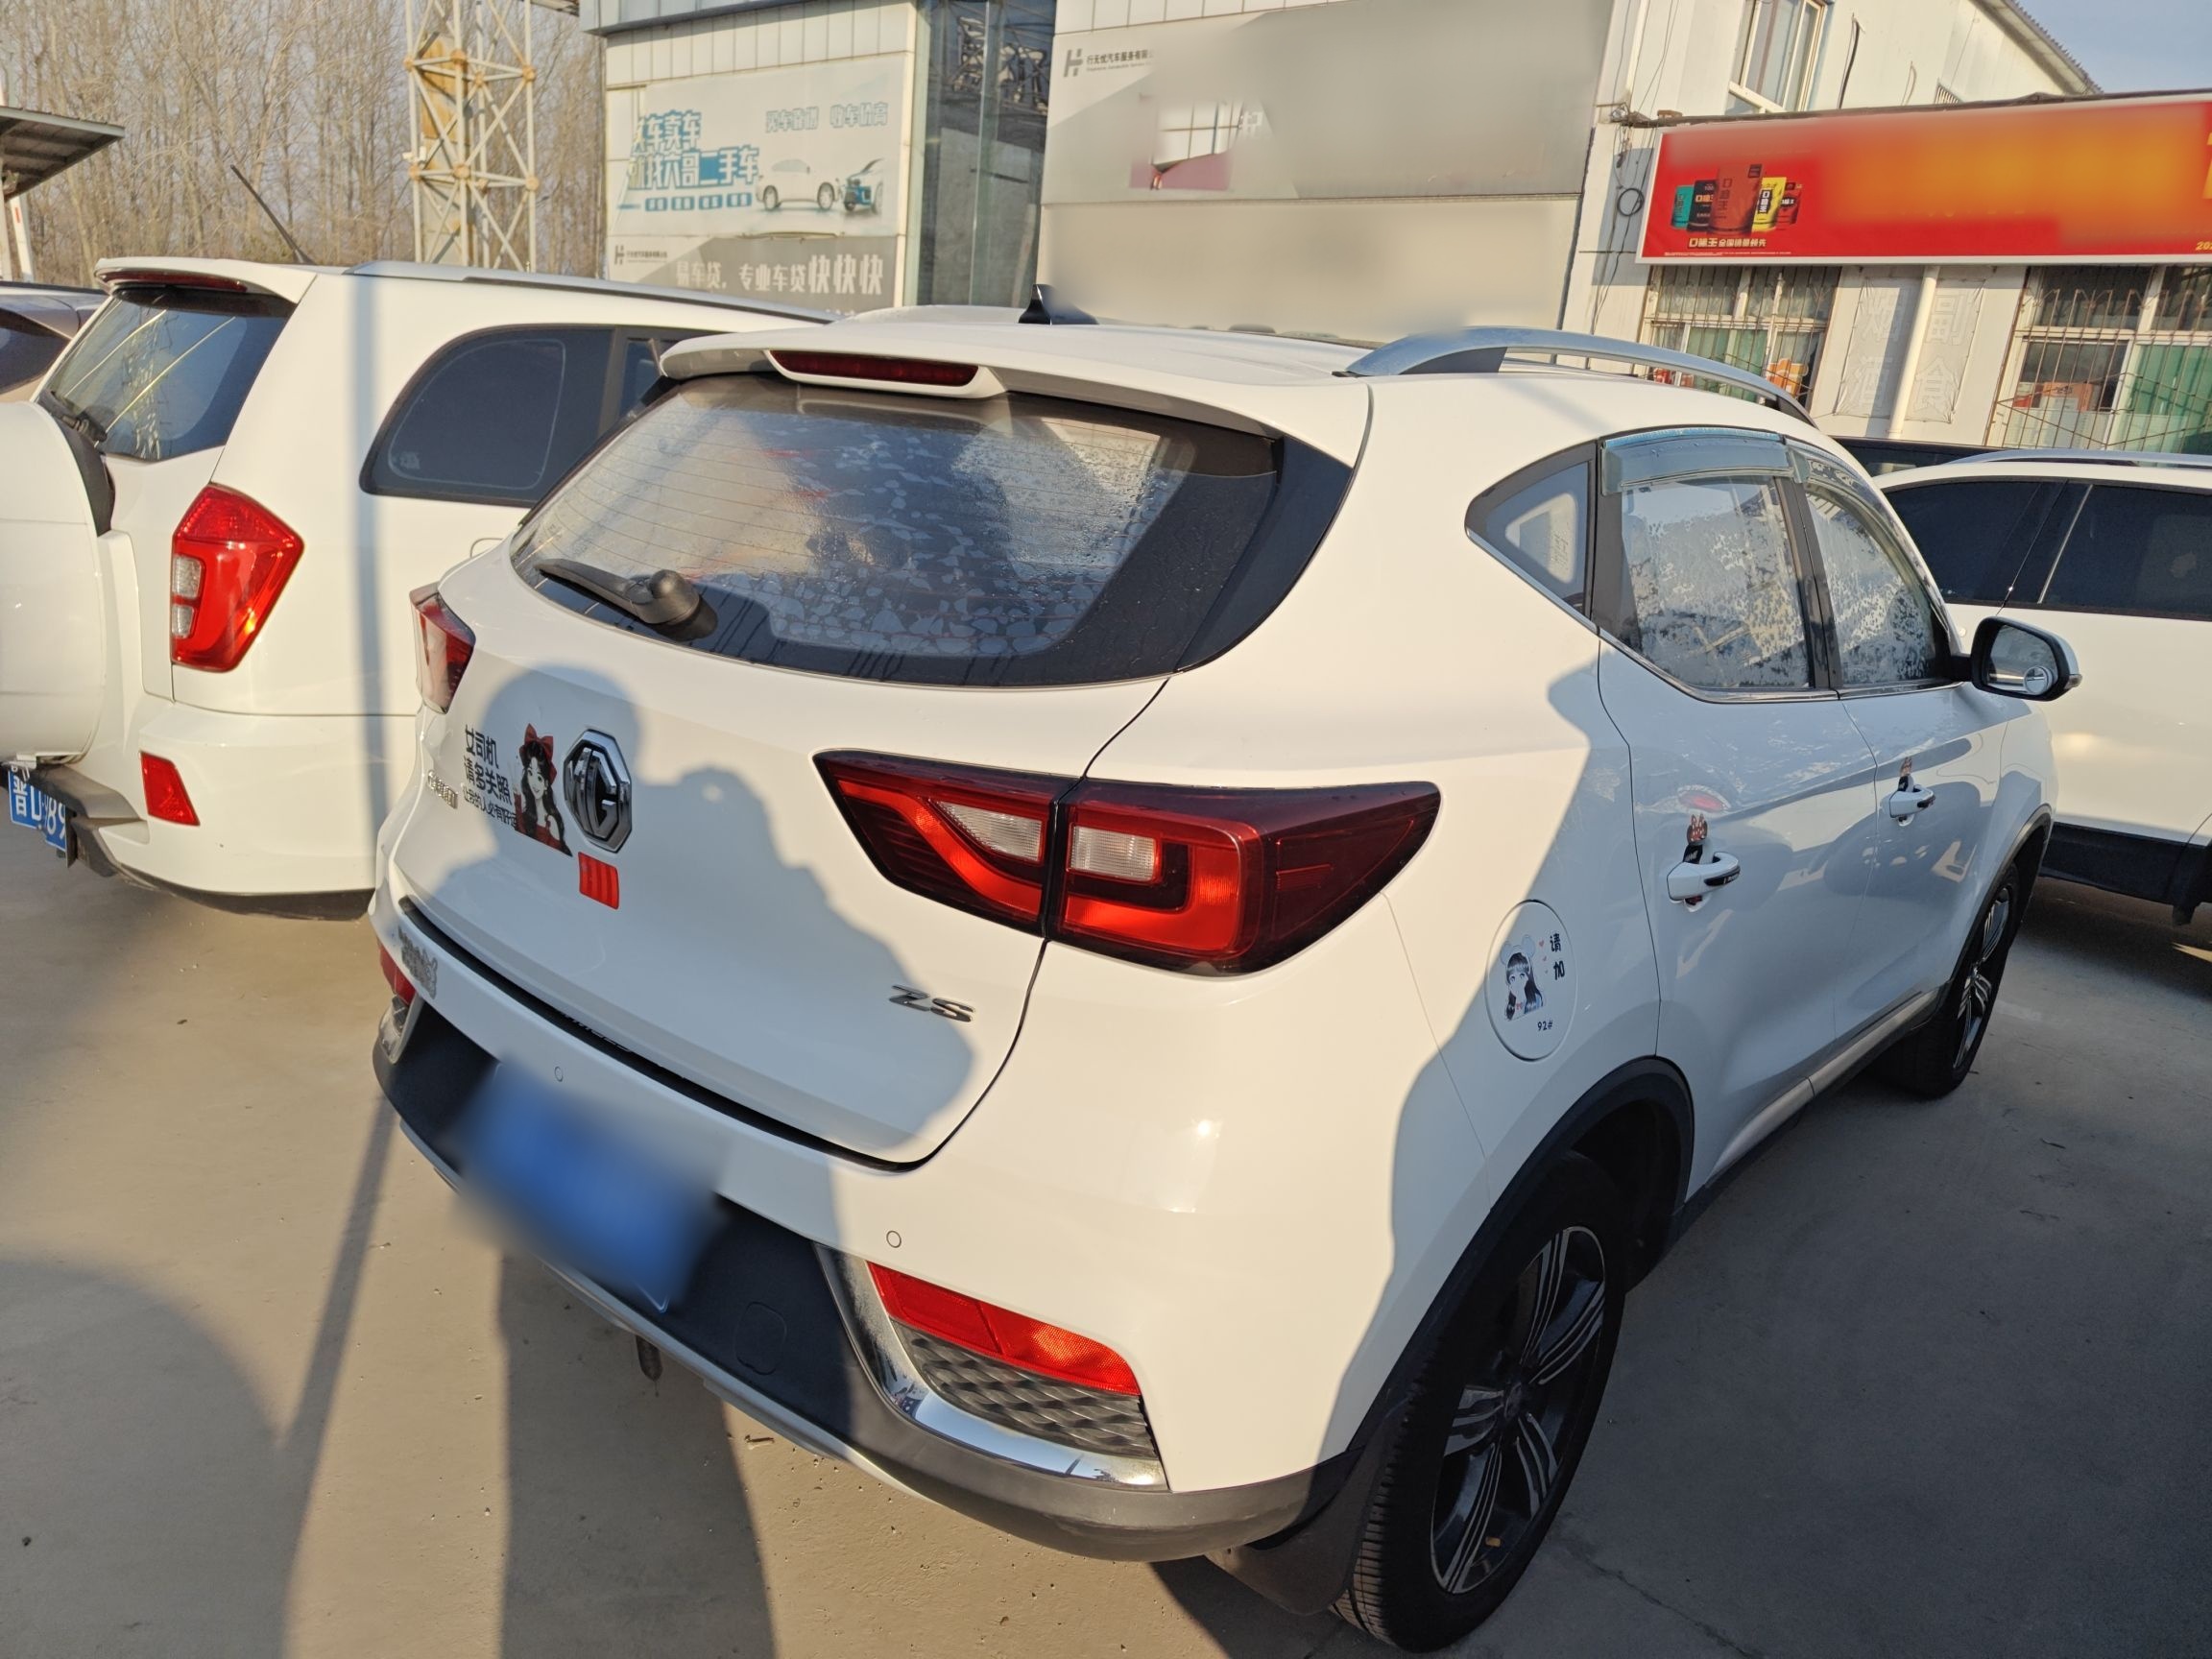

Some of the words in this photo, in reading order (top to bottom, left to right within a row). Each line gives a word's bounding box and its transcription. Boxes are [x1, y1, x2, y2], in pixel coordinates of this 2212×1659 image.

[465, 724, 499, 769] 女司机
[463, 755, 513, 805] 请多关照
[889, 983, 975, 1022] ZS
[1537, 1021, 1552, 1031] 92#
